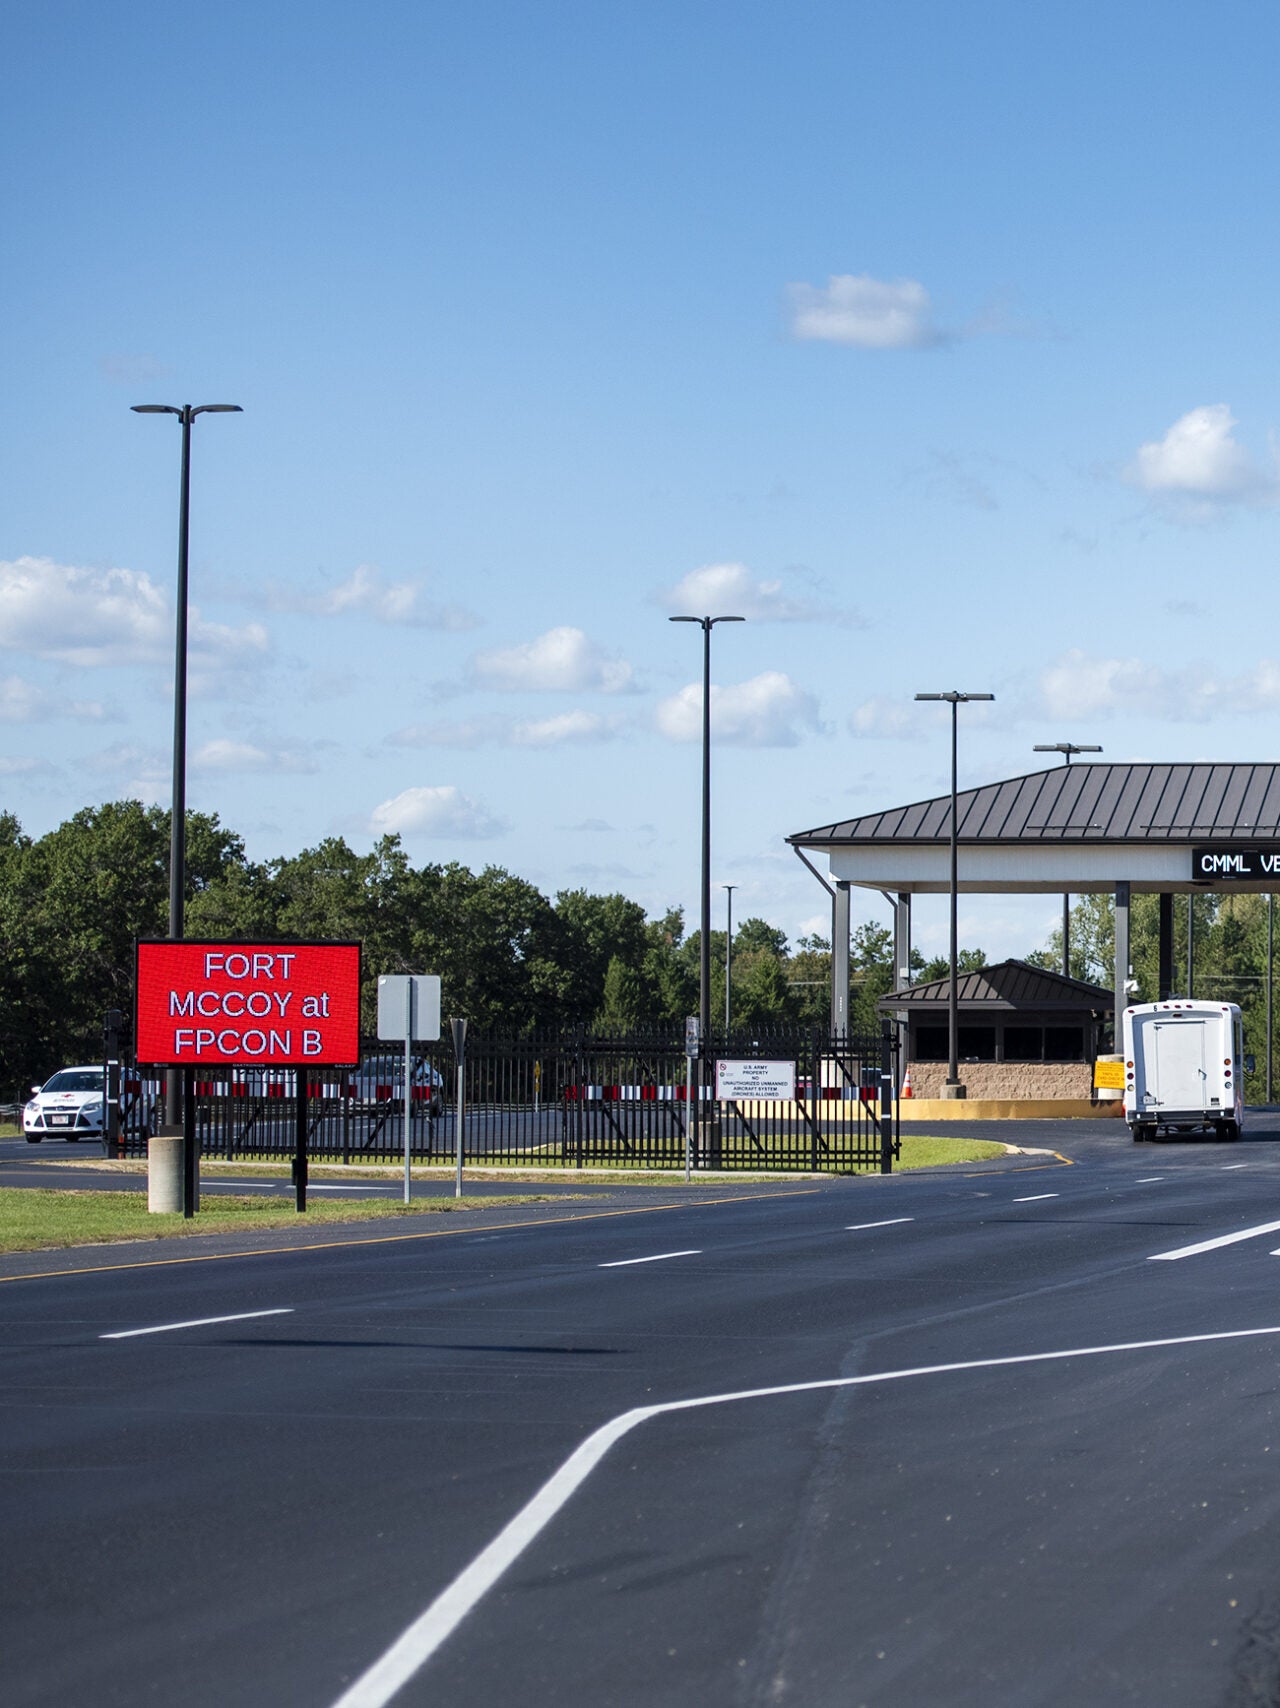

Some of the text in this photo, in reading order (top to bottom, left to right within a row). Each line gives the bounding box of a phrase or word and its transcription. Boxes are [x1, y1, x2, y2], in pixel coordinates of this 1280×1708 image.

[1201, 854, 1251, 872] CMML
[204, 953, 296, 979] FORT
[169, 991, 330, 1018] MCCOY at
[174, 1029, 323, 1056] FPCON B
